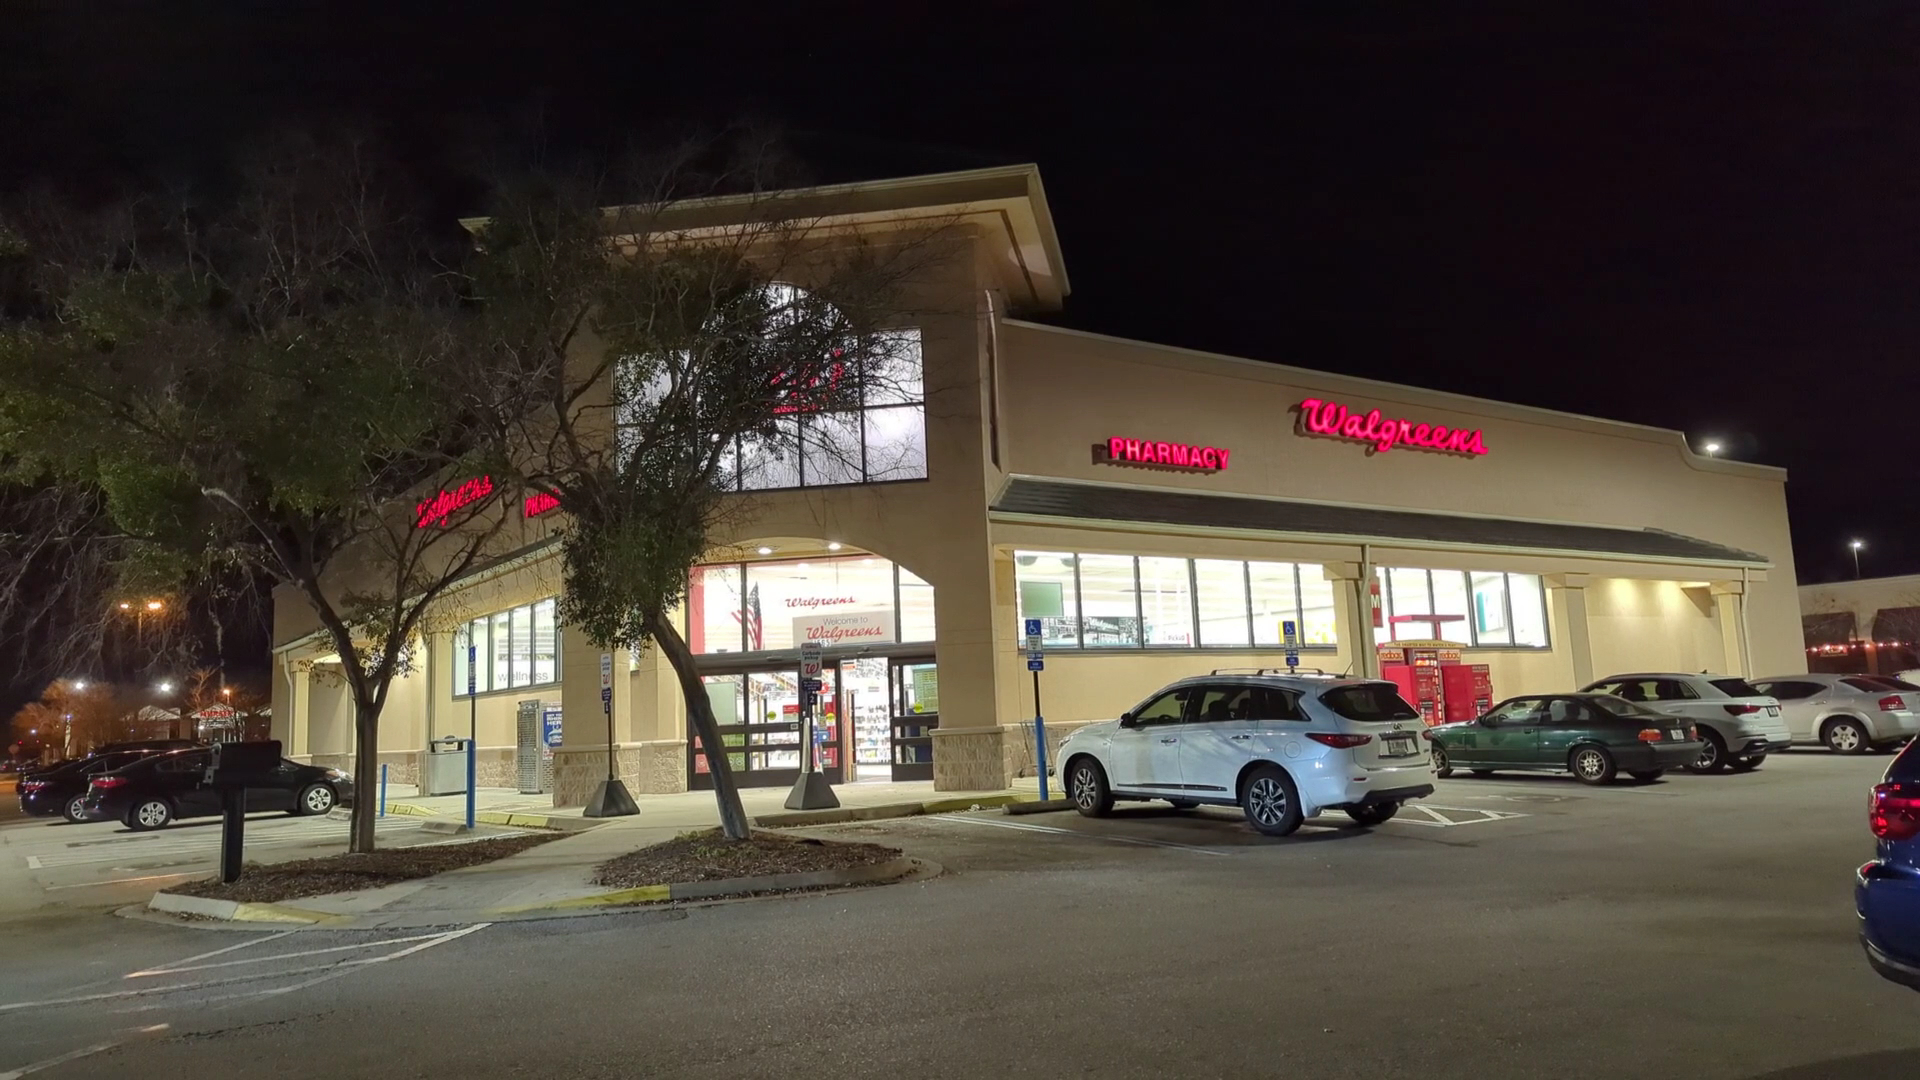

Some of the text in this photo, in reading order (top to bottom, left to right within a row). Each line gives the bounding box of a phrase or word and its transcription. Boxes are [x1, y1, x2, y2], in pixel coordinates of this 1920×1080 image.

[1301, 397, 1489, 455] Walgreens
[1109, 436, 1230, 470] PHARMACY
[785, 596, 855, 610] Walgreens
[824, 617, 858, 626] Welcome
[806, 626, 883, 642] Walgreens
